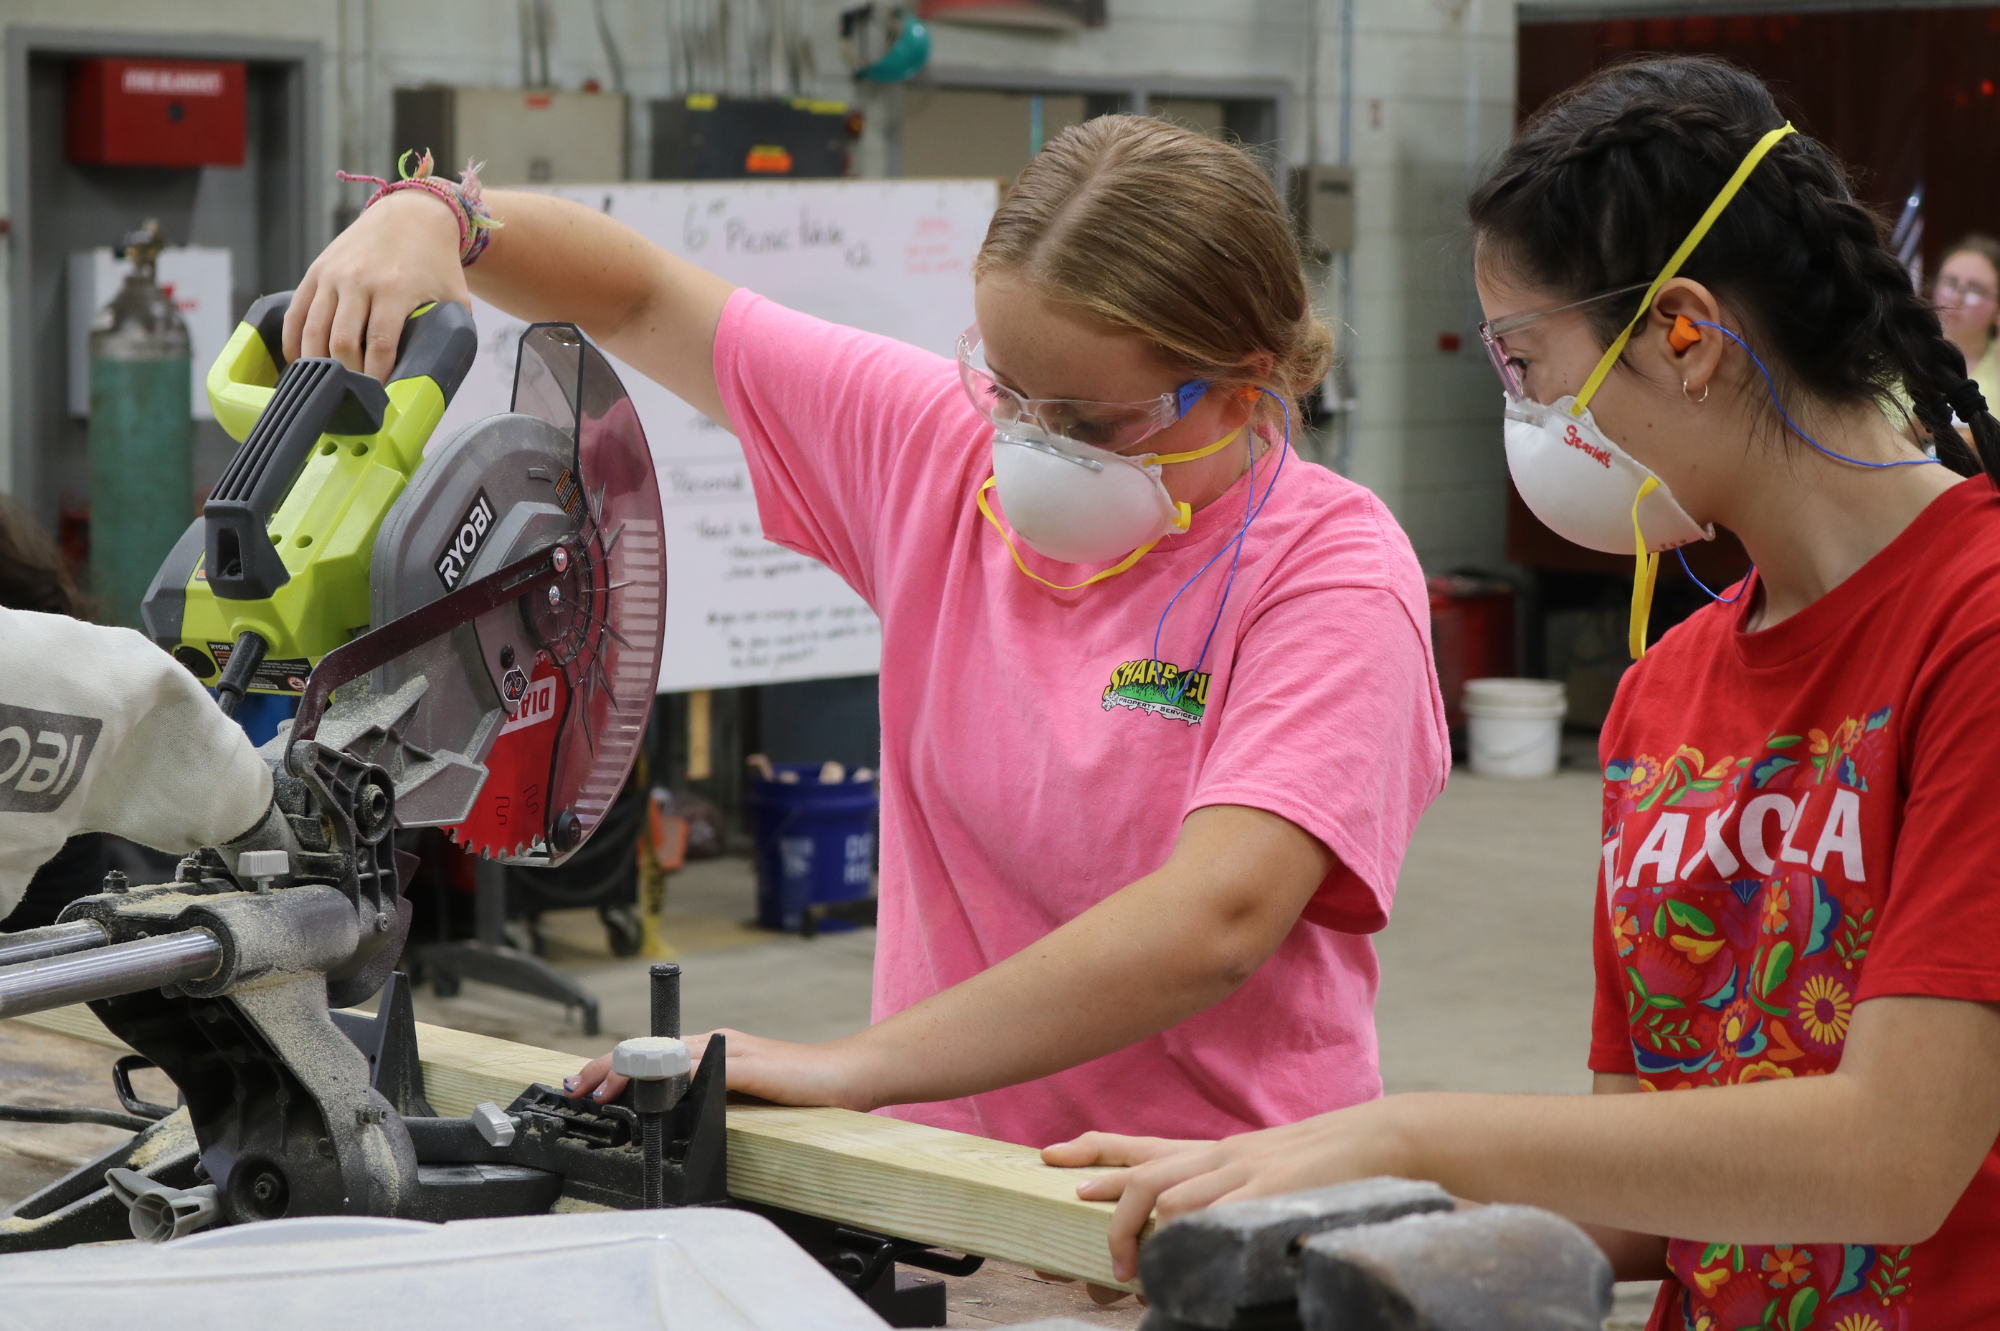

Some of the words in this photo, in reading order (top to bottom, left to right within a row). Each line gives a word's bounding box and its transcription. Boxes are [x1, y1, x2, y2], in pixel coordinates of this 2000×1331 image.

[439, 496, 493, 588] RYOBI
[1103, 659, 1178, 700] SHARP
[1119, 697, 1156, 710] PROPERTY
[1160, 706, 1198, 721] SERVICES
